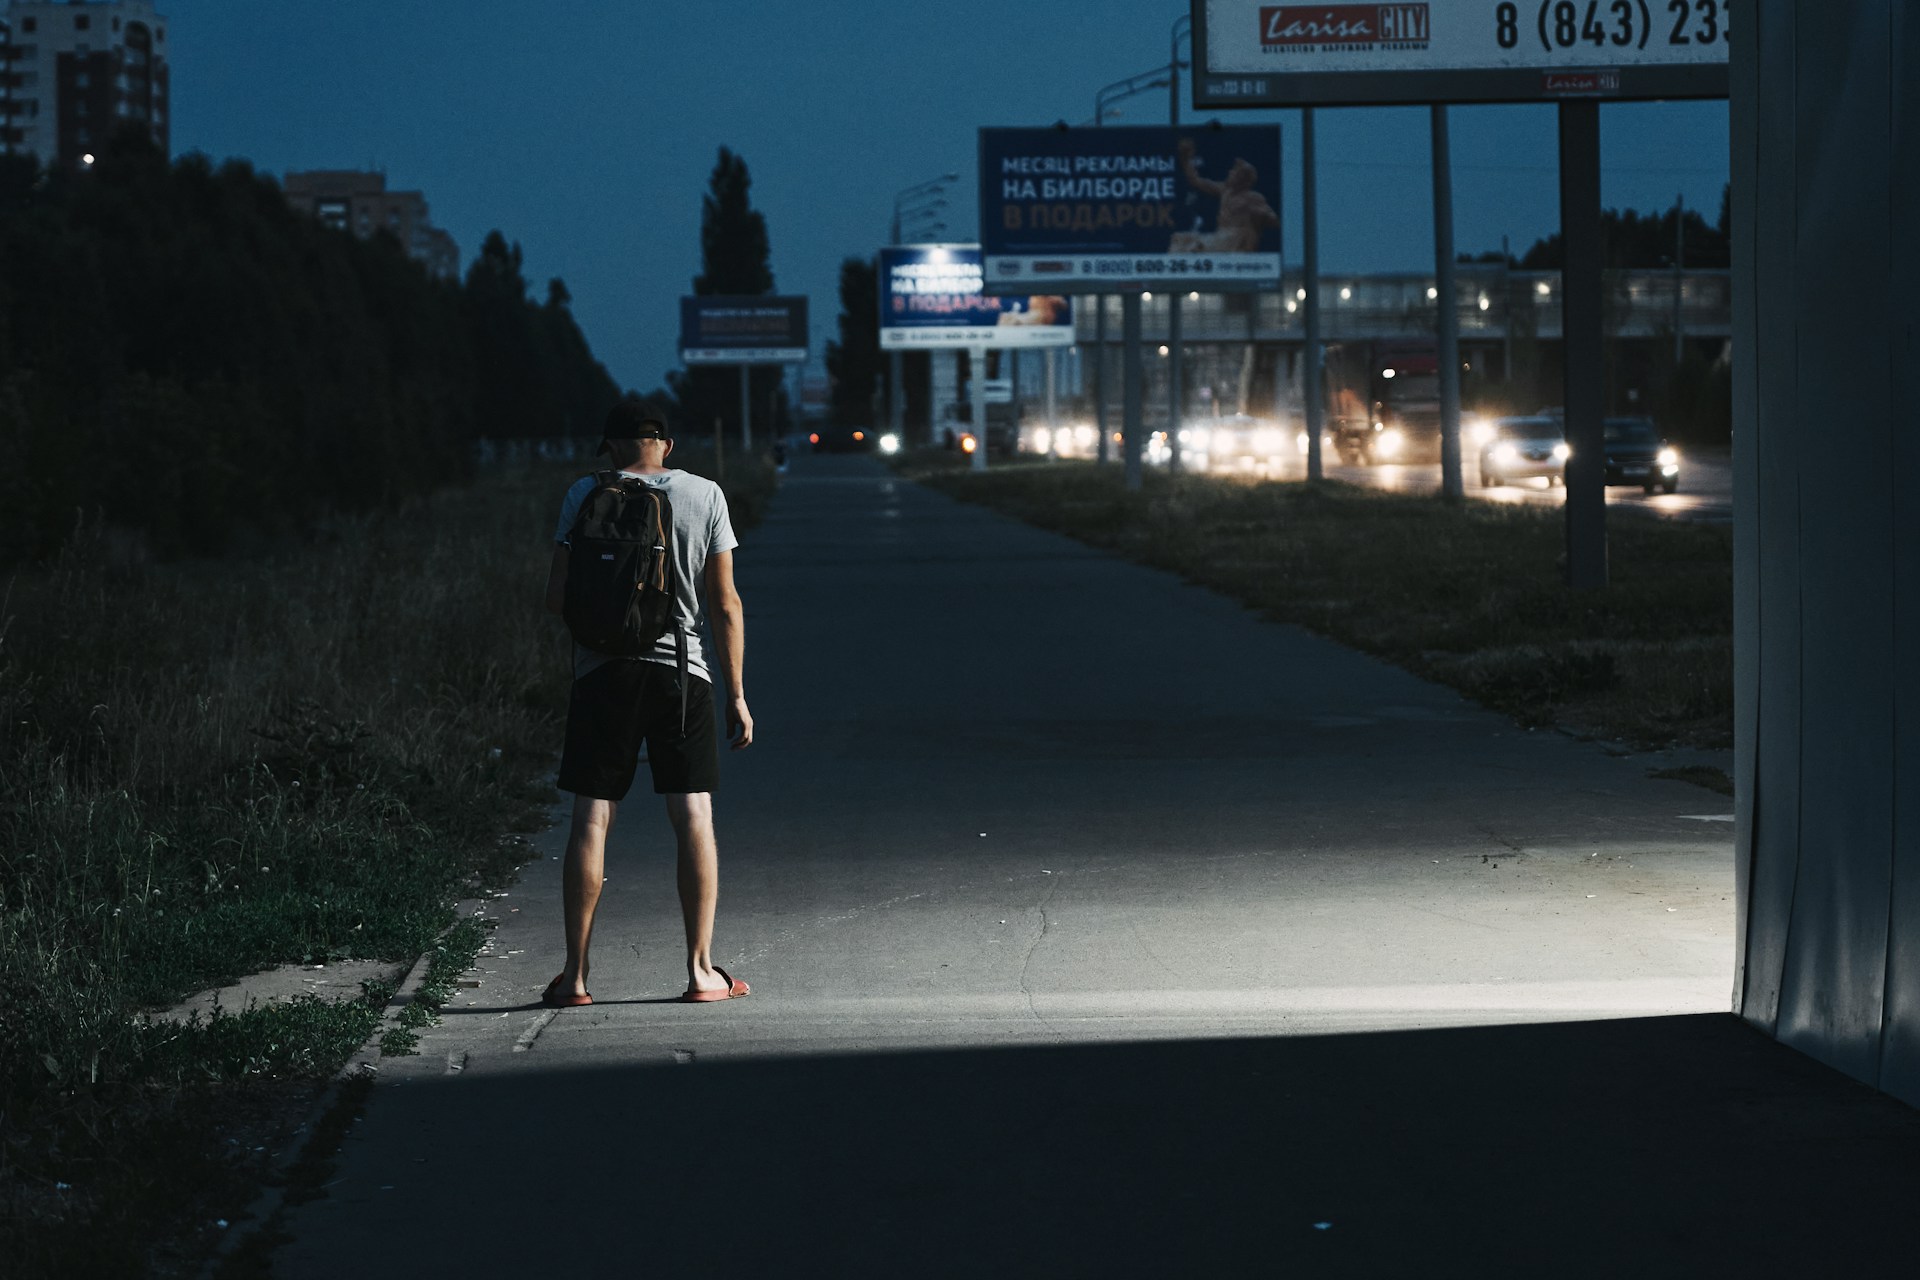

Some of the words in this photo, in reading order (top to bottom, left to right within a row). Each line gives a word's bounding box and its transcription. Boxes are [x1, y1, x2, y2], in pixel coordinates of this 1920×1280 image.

[1266, 10, 1374, 40] Larisa
[1379, 6, 1426, 39] CITY
[1496, 1, 1518, 49] 8
[1538, 0, 1651, 52] (843)
[1668, 0, 1729, 45] 23
[1002, 156, 1071, 175] МЕСЯЦ
[1075, 156, 1175, 173] РЕКЛАМЫ
[1002, 179, 1037, 199] НА
[1042, 177, 1175, 200] БИЛБОРДЕ
[1003, 205, 1022, 229] В
[1030, 204, 1175, 232] ПОДАРОК
